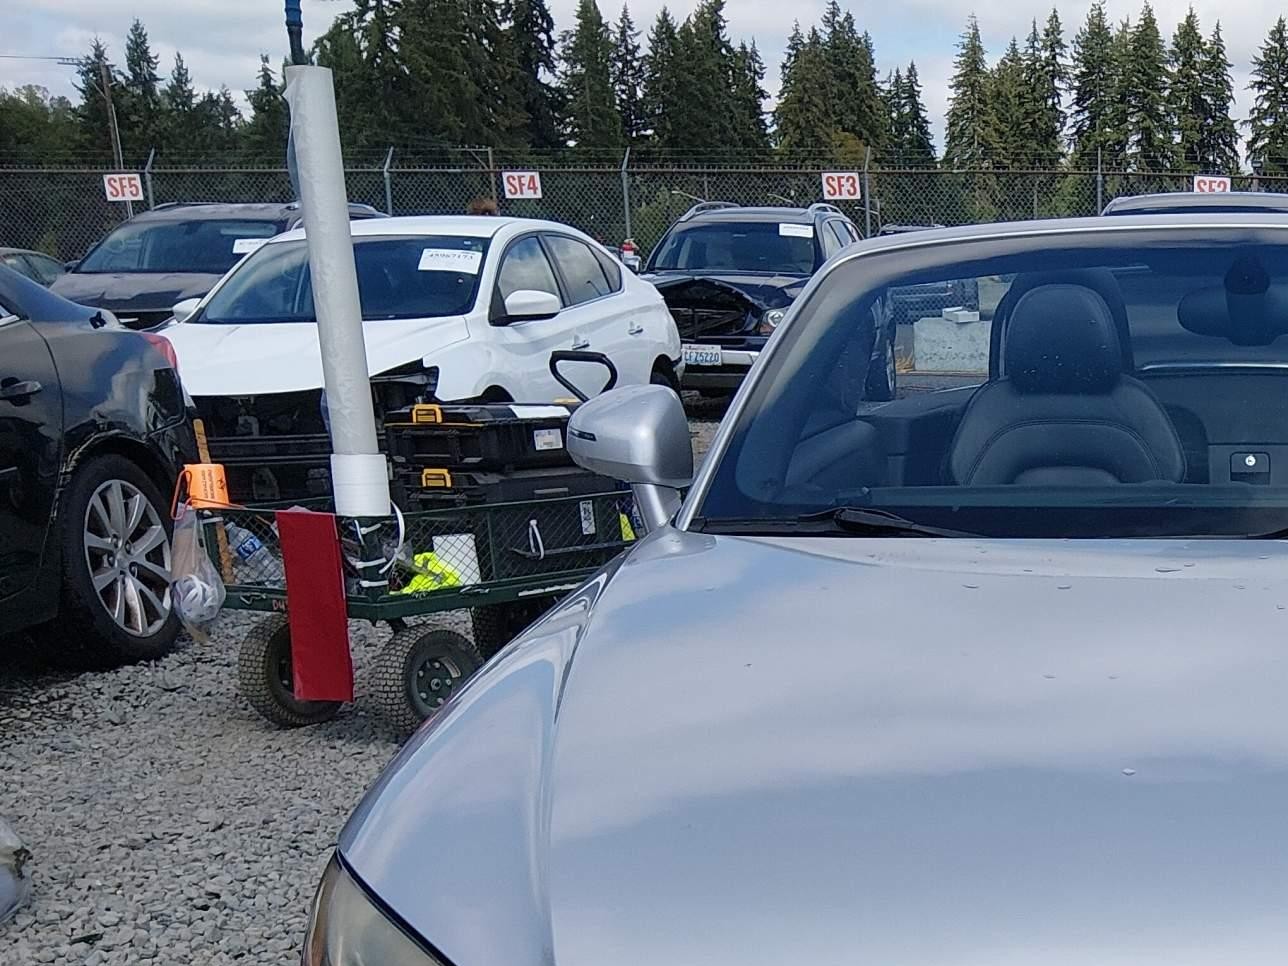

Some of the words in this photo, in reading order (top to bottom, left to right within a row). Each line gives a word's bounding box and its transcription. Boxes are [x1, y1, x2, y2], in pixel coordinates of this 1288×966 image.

[107, 176, 140, 198] SF5
[506, 175, 539, 195] SF4
[825, 175, 858, 196] SF3
